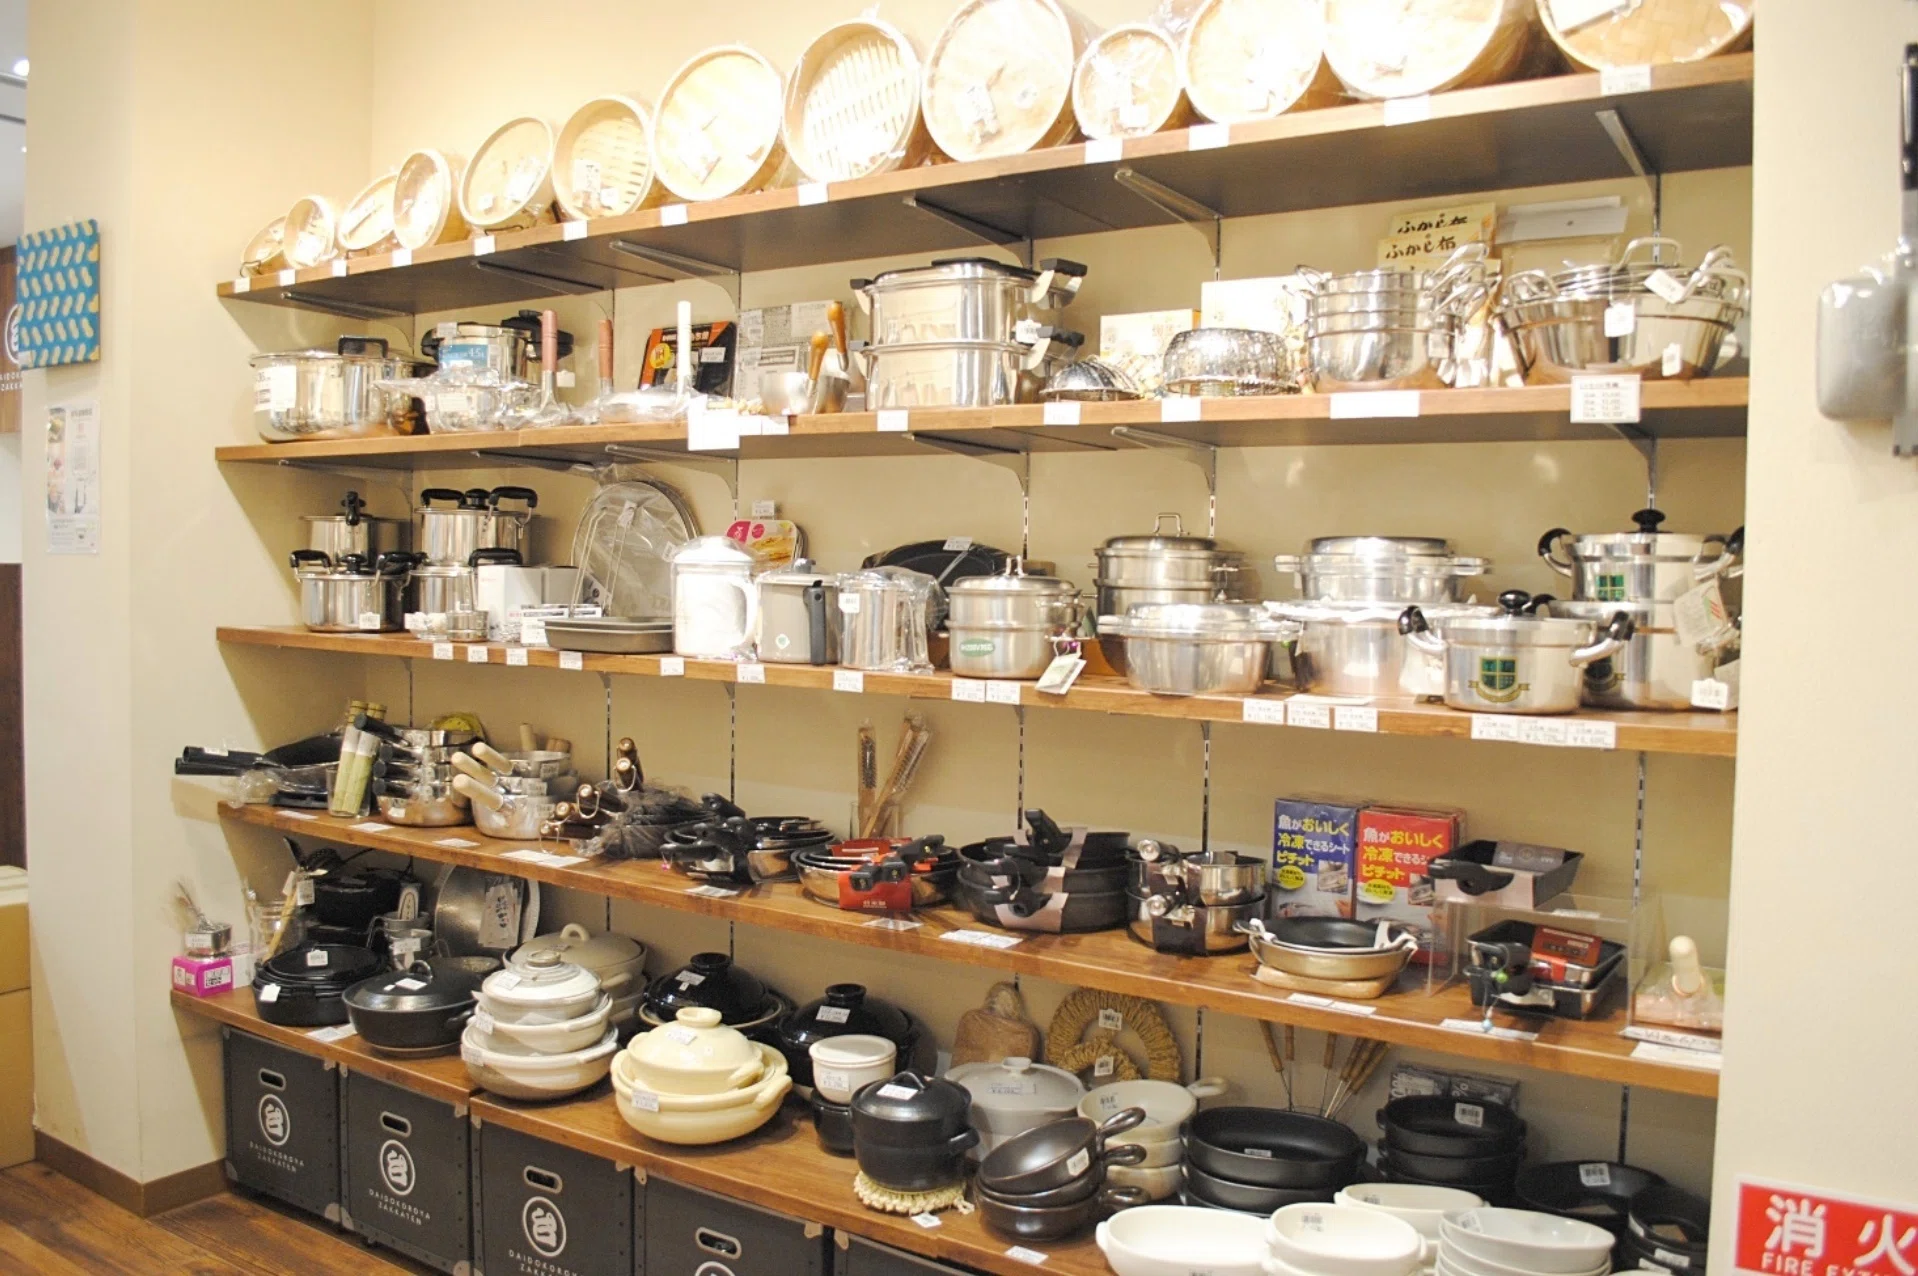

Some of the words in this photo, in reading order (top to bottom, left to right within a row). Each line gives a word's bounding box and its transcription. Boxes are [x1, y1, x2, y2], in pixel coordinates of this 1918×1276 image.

[1278, 815, 1350, 837] 魚がおいしく
[1363, 827, 1444, 849] 魚がおいしく
[1277, 832, 1351, 855] 冷凍できるシート
[1362, 845, 1430, 865] 冷凍できるシ
[368, 1188, 431, 1220] DAIDOKOROYA
[378, 1201, 422, 1226] ZAKKATEN
[1765, 1194, 1917, 1276] 消火
[508, 1249, 586, 1276] DAIDOKOROY
[1761, 1252, 1814, 1276] FIRE
